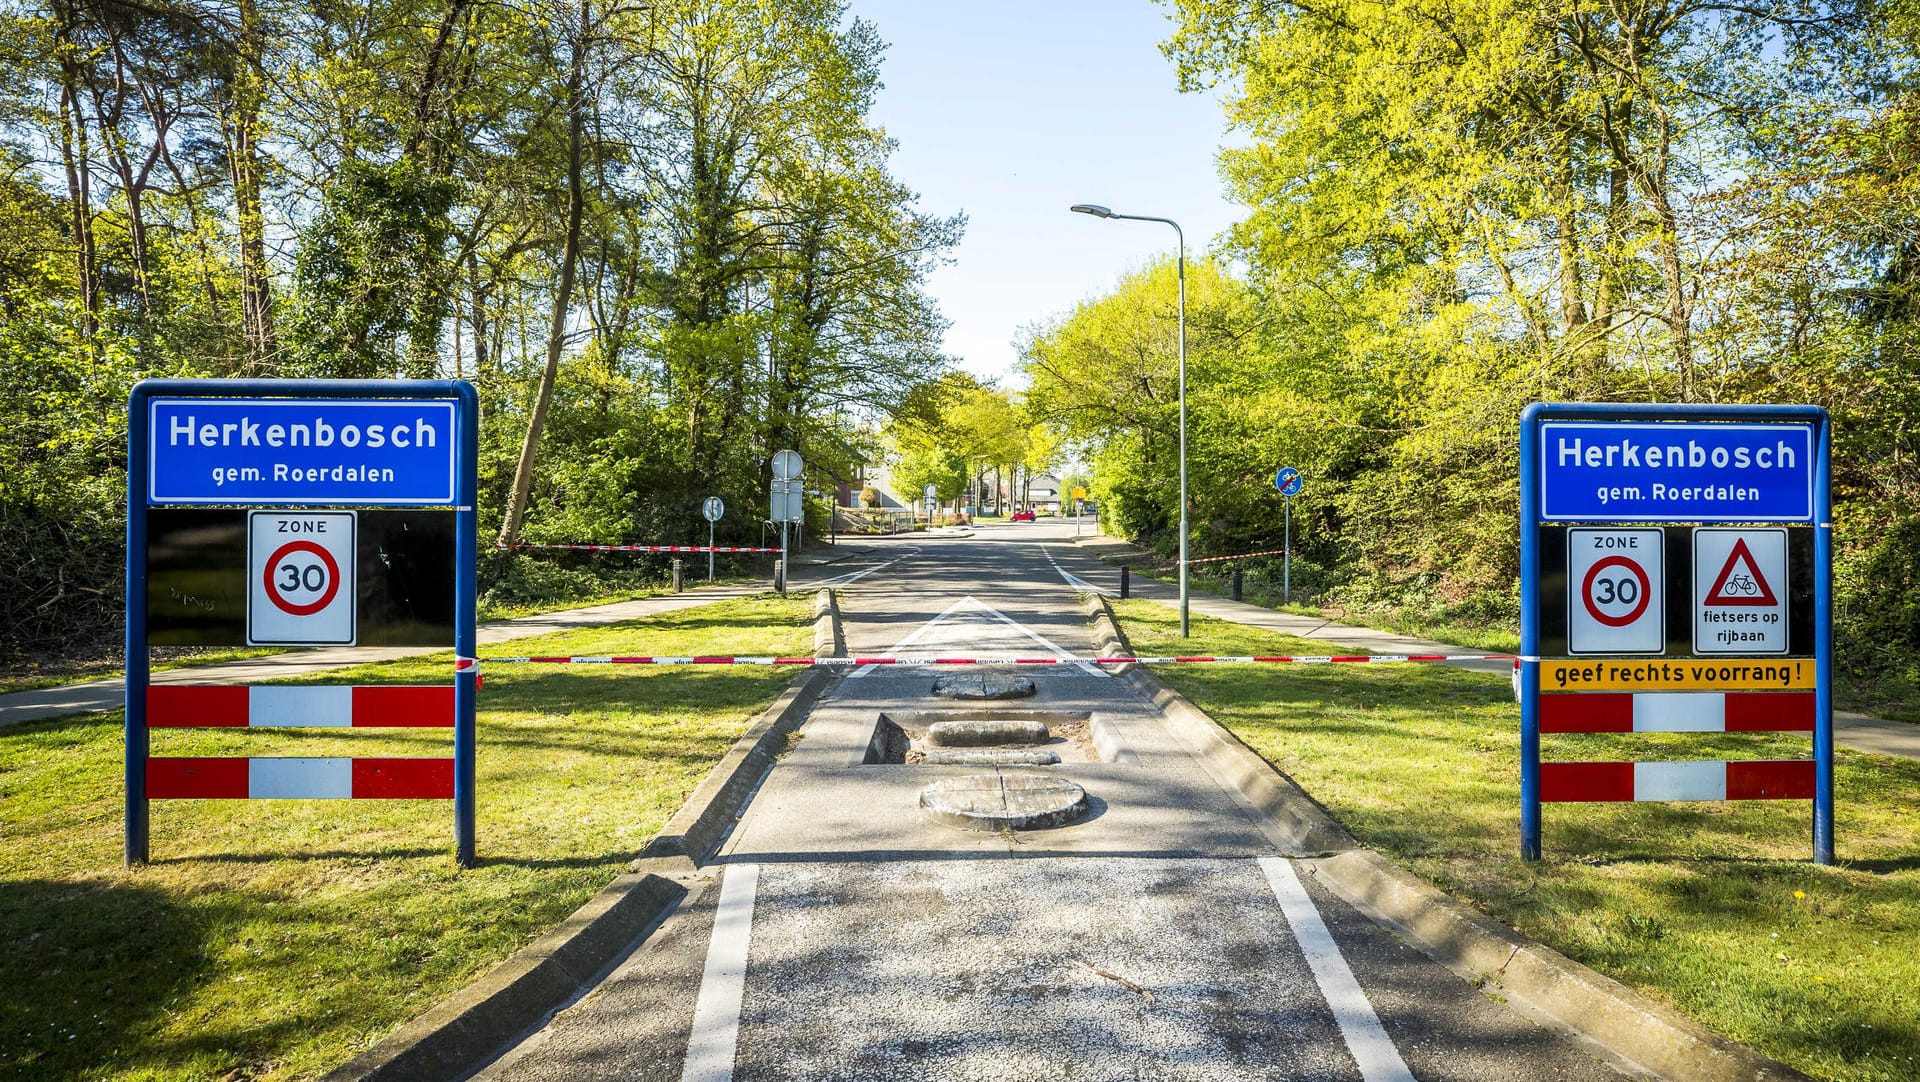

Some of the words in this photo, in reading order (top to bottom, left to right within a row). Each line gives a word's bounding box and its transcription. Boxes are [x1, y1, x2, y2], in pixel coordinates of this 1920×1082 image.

[170, 413, 436, 448] Herkenbosch
[1558, 436, 1795, 469] Herkenbosch
[212, 467, 266, 486] gem.
[274, 463, 394, 482] Roerdalen
[1597, 487, 1646, 505] gem.
[1652, 483, 1759, 501] Roerdalen
[278, 520, 327, 533] ZONE
[1594, 536, 1638, 549] ZONE
[278, 564, 325, 592] 30
[1596, 578, 1638, 605] 30
[1703, 610, 1758, 623] fietsers
[1762, 613, 1779, 625] op
[1717, 629, 1765, 645] rijbaan
[1555, 662, 1604, 688] geef
[1610, 663, 1685, 682] rechts
